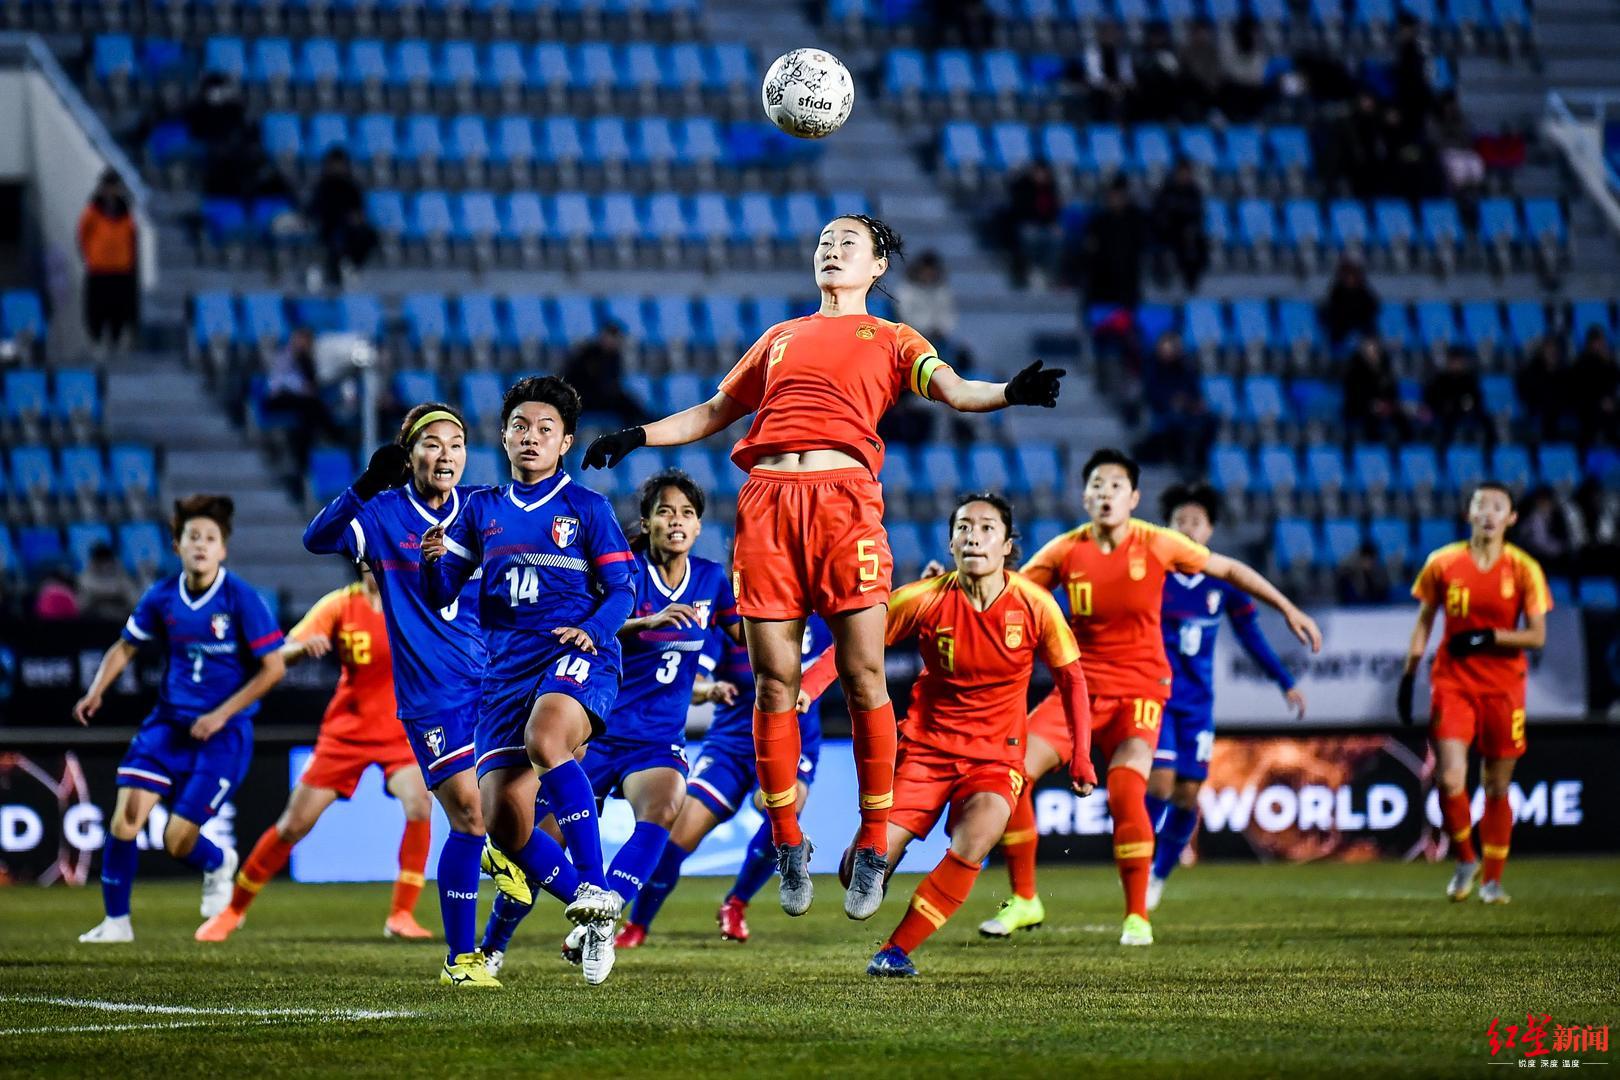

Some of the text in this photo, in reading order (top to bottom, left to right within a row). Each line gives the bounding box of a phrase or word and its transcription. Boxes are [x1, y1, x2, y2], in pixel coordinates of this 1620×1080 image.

[798, 96, 832, 110] sfida
[769, 333, 793, 369] 5
[857, 539, 879, 581] 5
[505, 566, 539, 607] 14
[1069, 581, 1092, 616] 10
[555, 654, 591, 684] 14
[655, 650, 682, 684] 3
[937, 636, 954, 673] 9
[1133, 698, 1161, 730] 10
[1196, 783, 1408, 833] WORLD
